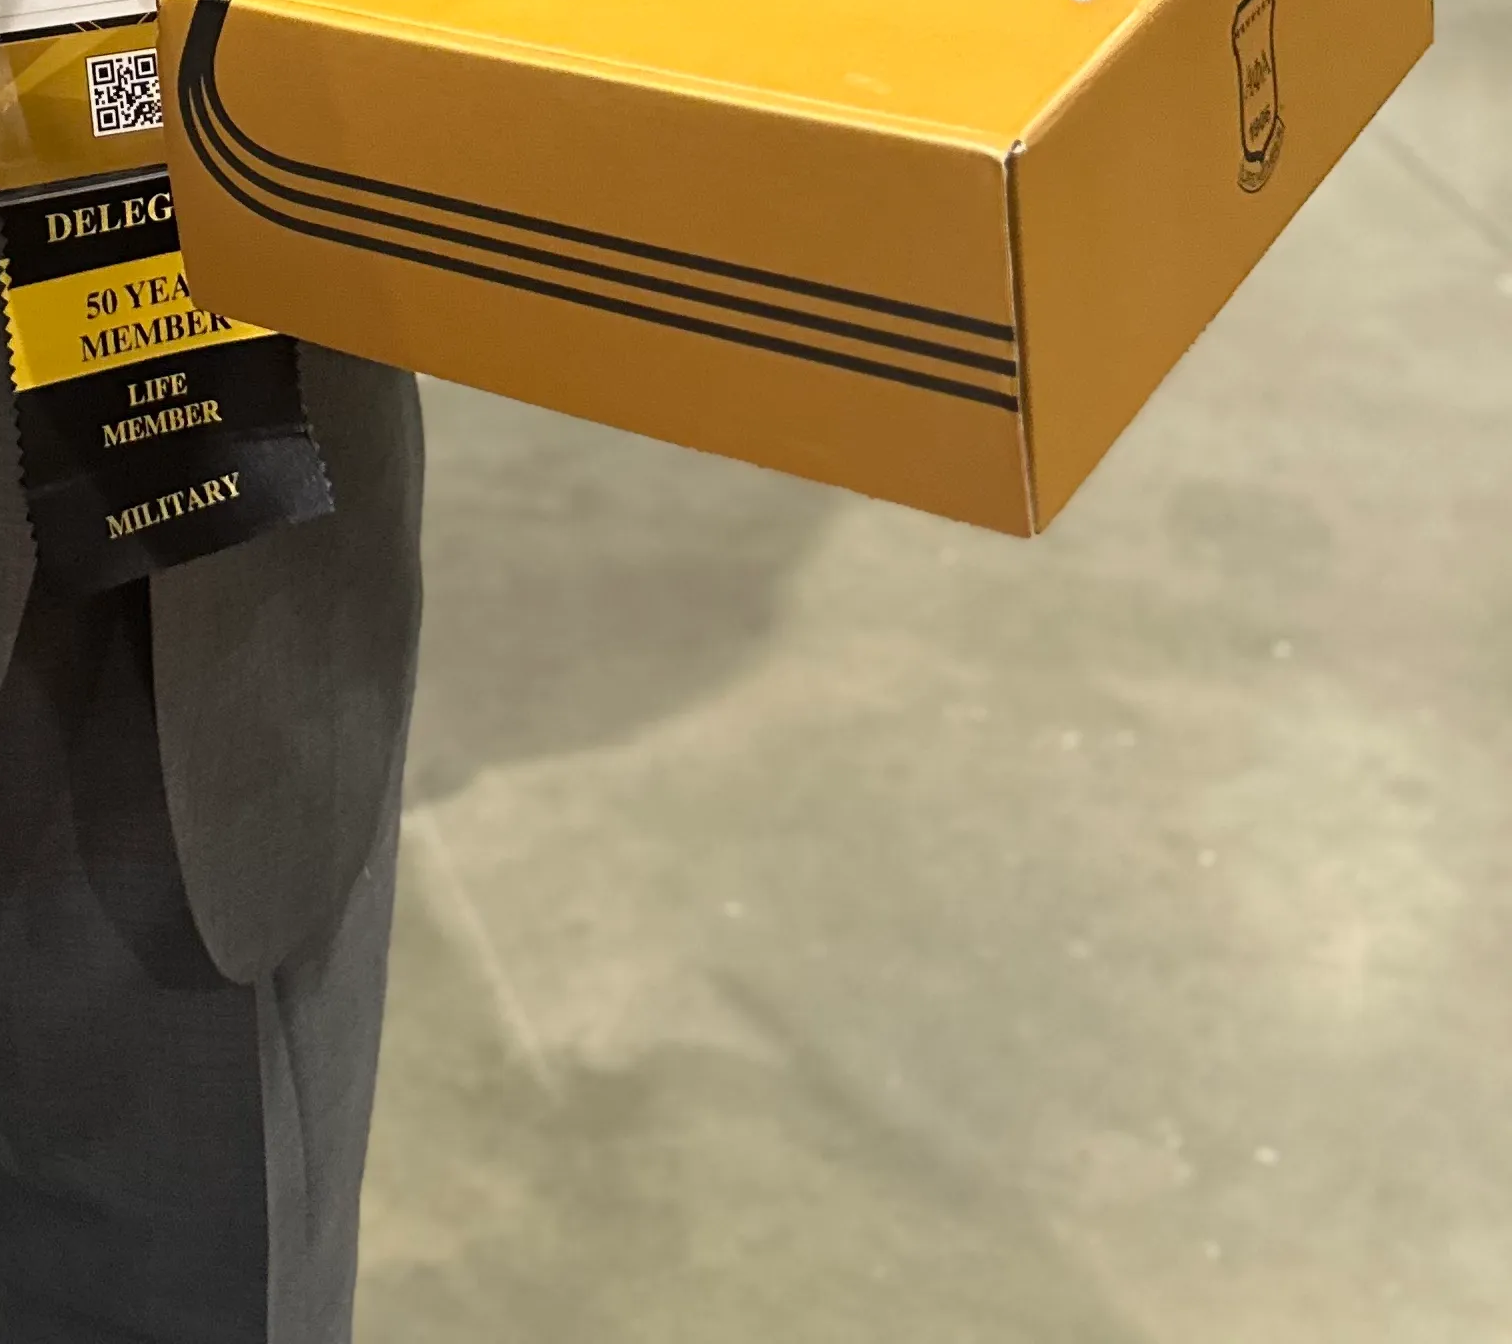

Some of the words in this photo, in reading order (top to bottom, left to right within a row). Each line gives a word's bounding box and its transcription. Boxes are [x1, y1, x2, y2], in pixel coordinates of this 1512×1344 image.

[84, 287, 119, 320] 50
[79, 310, 233, 363] MEMBER
[127, 372, 189, 408] LIFE
[102, 399, 223, 449] MEMBER
[105, 472, 241, 540] MILITARY
